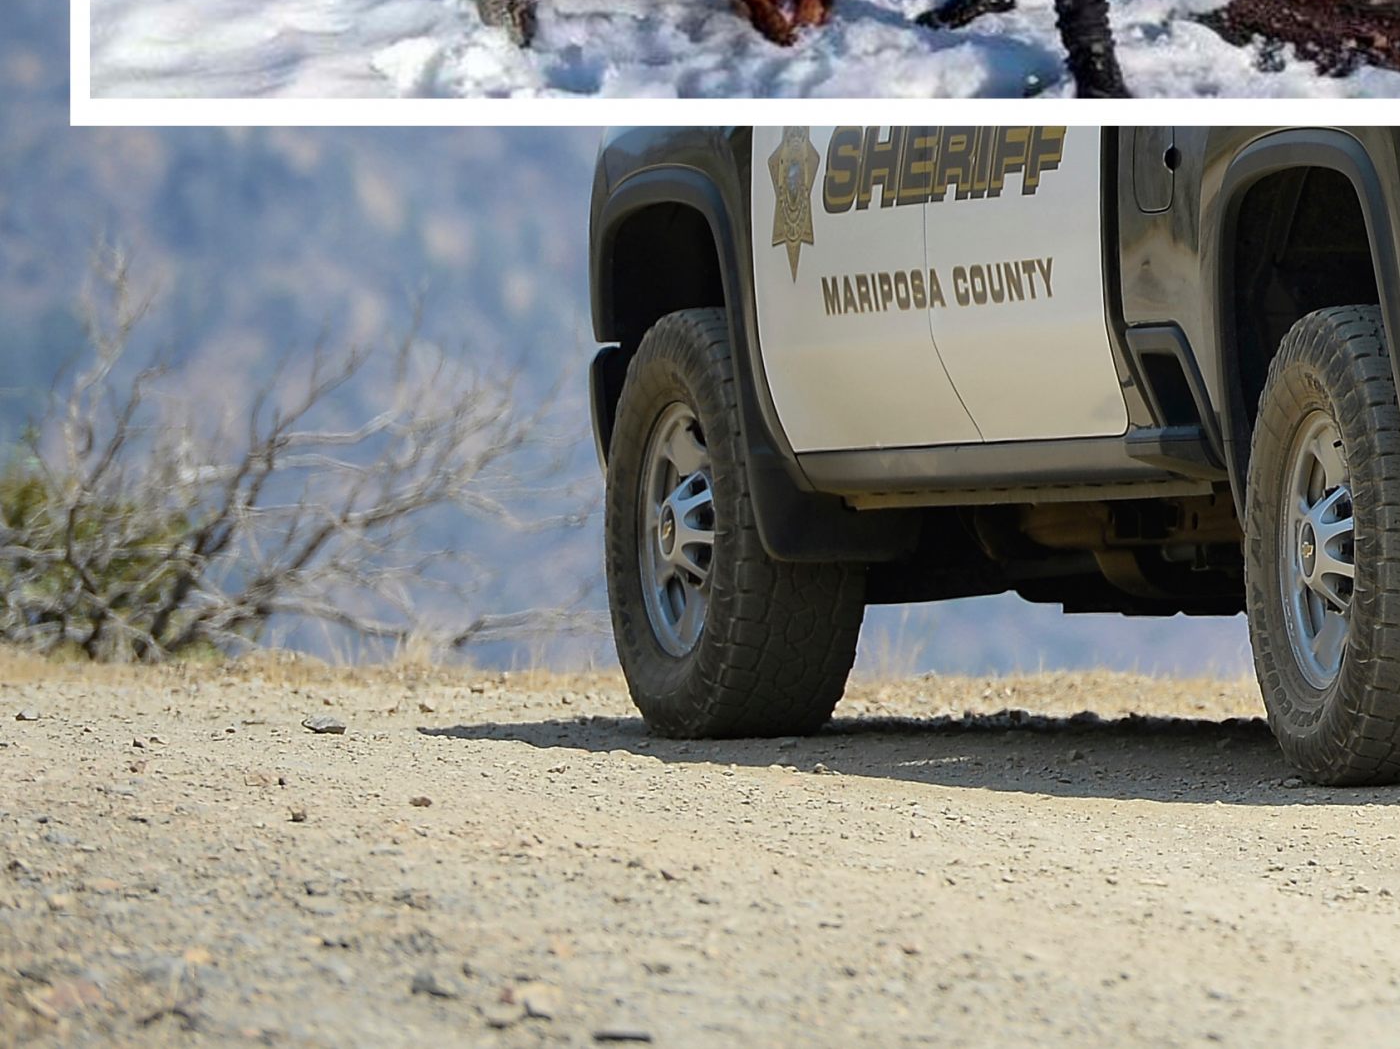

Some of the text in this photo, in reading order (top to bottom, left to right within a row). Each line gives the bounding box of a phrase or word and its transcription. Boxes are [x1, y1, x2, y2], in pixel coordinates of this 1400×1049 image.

[823, 126, 1066, 213] SHERIFF
[821, 257, 1053, 315] MARIPOSA COUNTY
